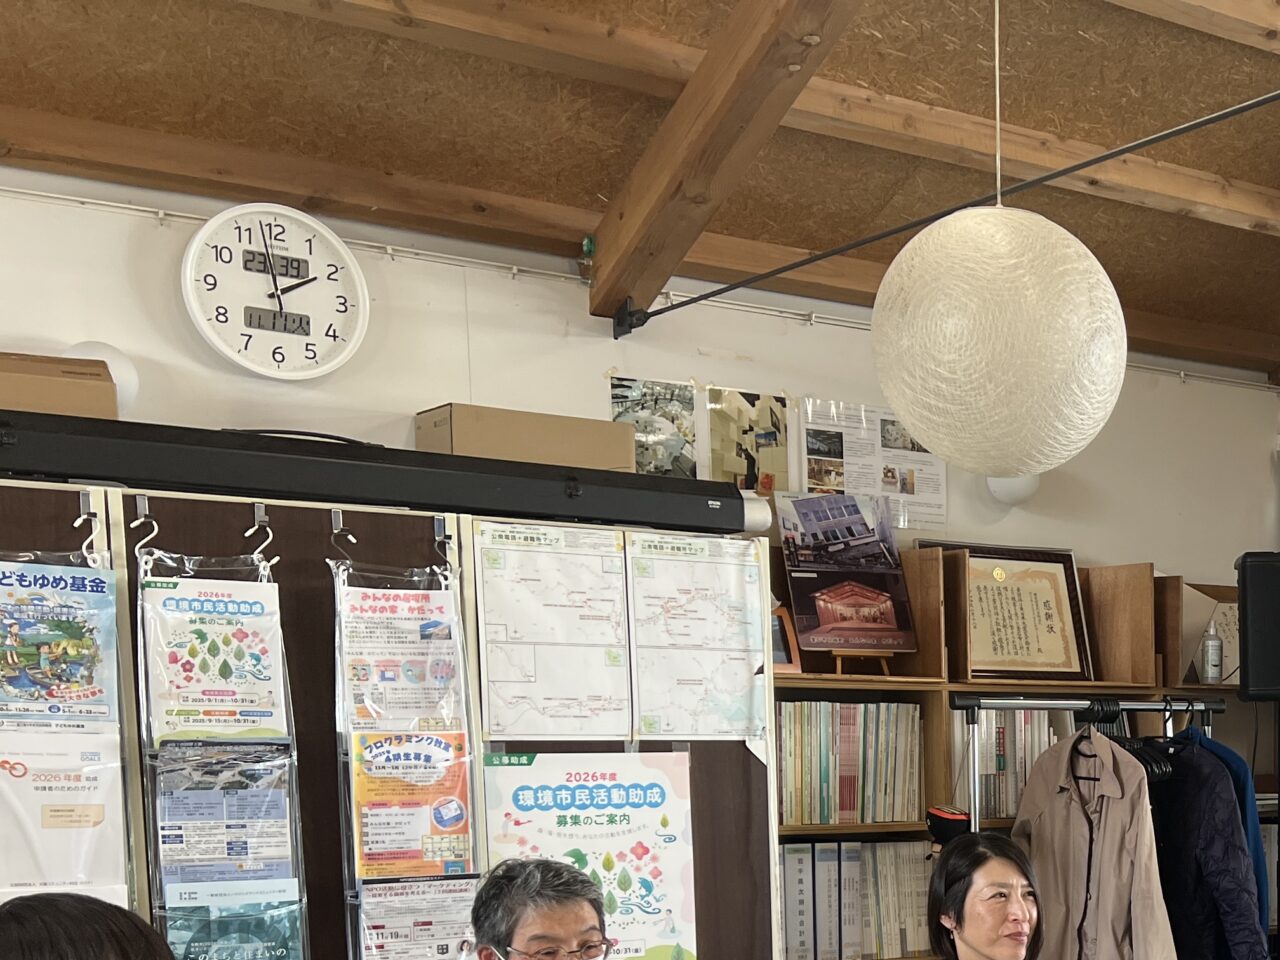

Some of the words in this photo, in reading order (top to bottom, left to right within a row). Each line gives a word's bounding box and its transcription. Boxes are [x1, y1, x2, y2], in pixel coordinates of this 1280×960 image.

[234, 226, 252, 245] 11
[265, 223, 286, 242] 12
[211, 245, 232, 264] 10
[305, 238, 313, 255] 1
[326, 264, 339, 281] 2
[203, 274, 217, 291] 9
[335, 296, 348, 313] 3
[215, 306, 229, 323] 8
[325, 323, 339, 341] 4
[240, 333, 253, 350] 7
[272, 347, 285, 363] 6
[304, 343, 317, 360] 5
[198, 591, 232, 599] 2026年度
[166, 600, 263, 614] 環境市民活動助成
[364, 735, 452, 753] プログラミング教室
[493, 756, 528, 765] 公募助成
[32, 774, 61, 782] 2026
[565, 772, 617, 783] 2026年度
[517, 786, 662, 807] 環境市民活動助成
[556, 813, 631, 828] 募集のご案内
